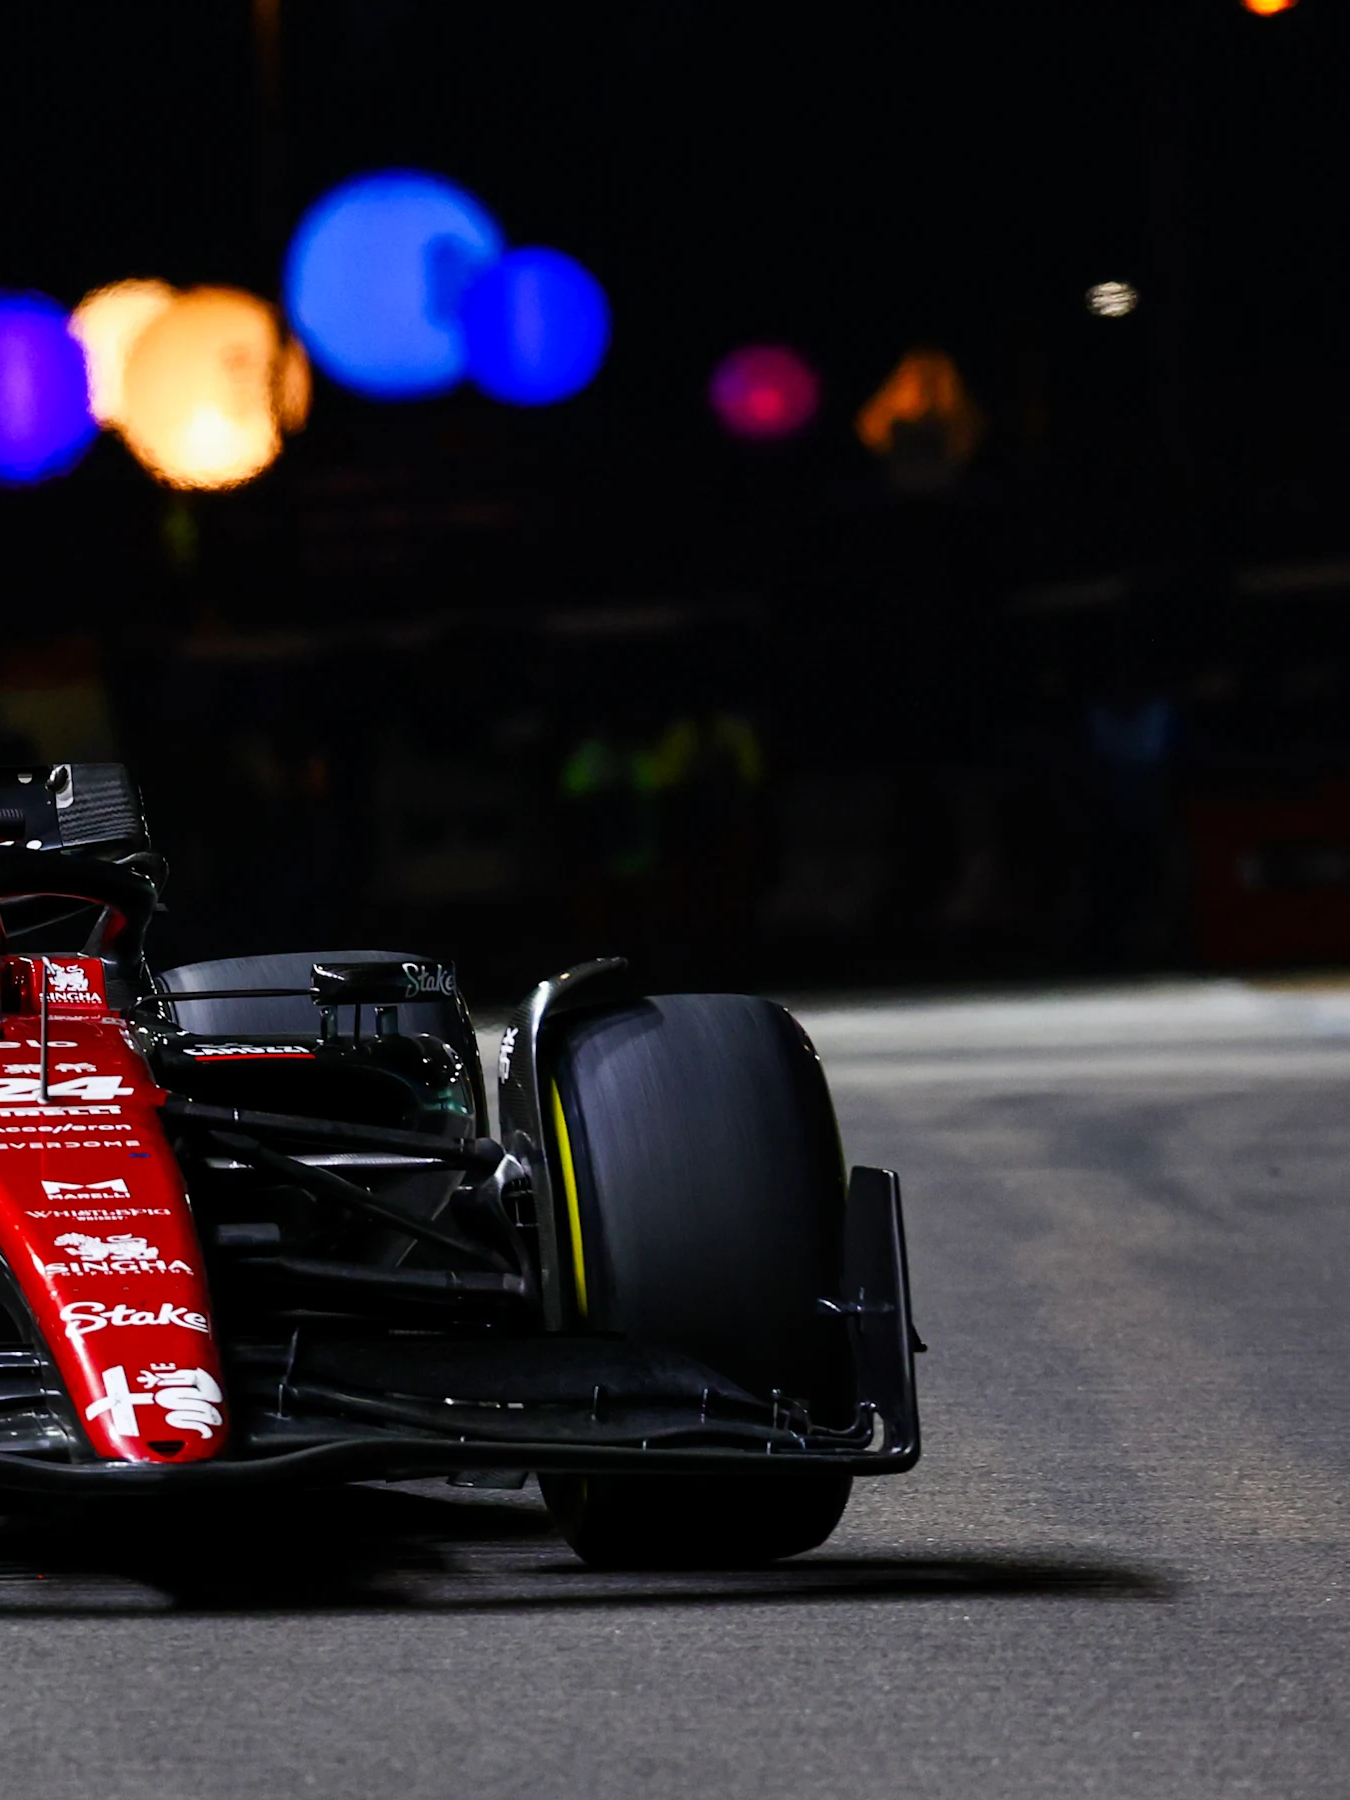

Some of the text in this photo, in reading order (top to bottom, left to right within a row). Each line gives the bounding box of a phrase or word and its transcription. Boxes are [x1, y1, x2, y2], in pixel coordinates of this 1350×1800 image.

[402, 963, 452, 997] Stake
[47, 1192, 131, 1200] MARELLI
[45, 1260, 192, 1275] SINGHA
[59, 1301, 210, 1338] Stake
